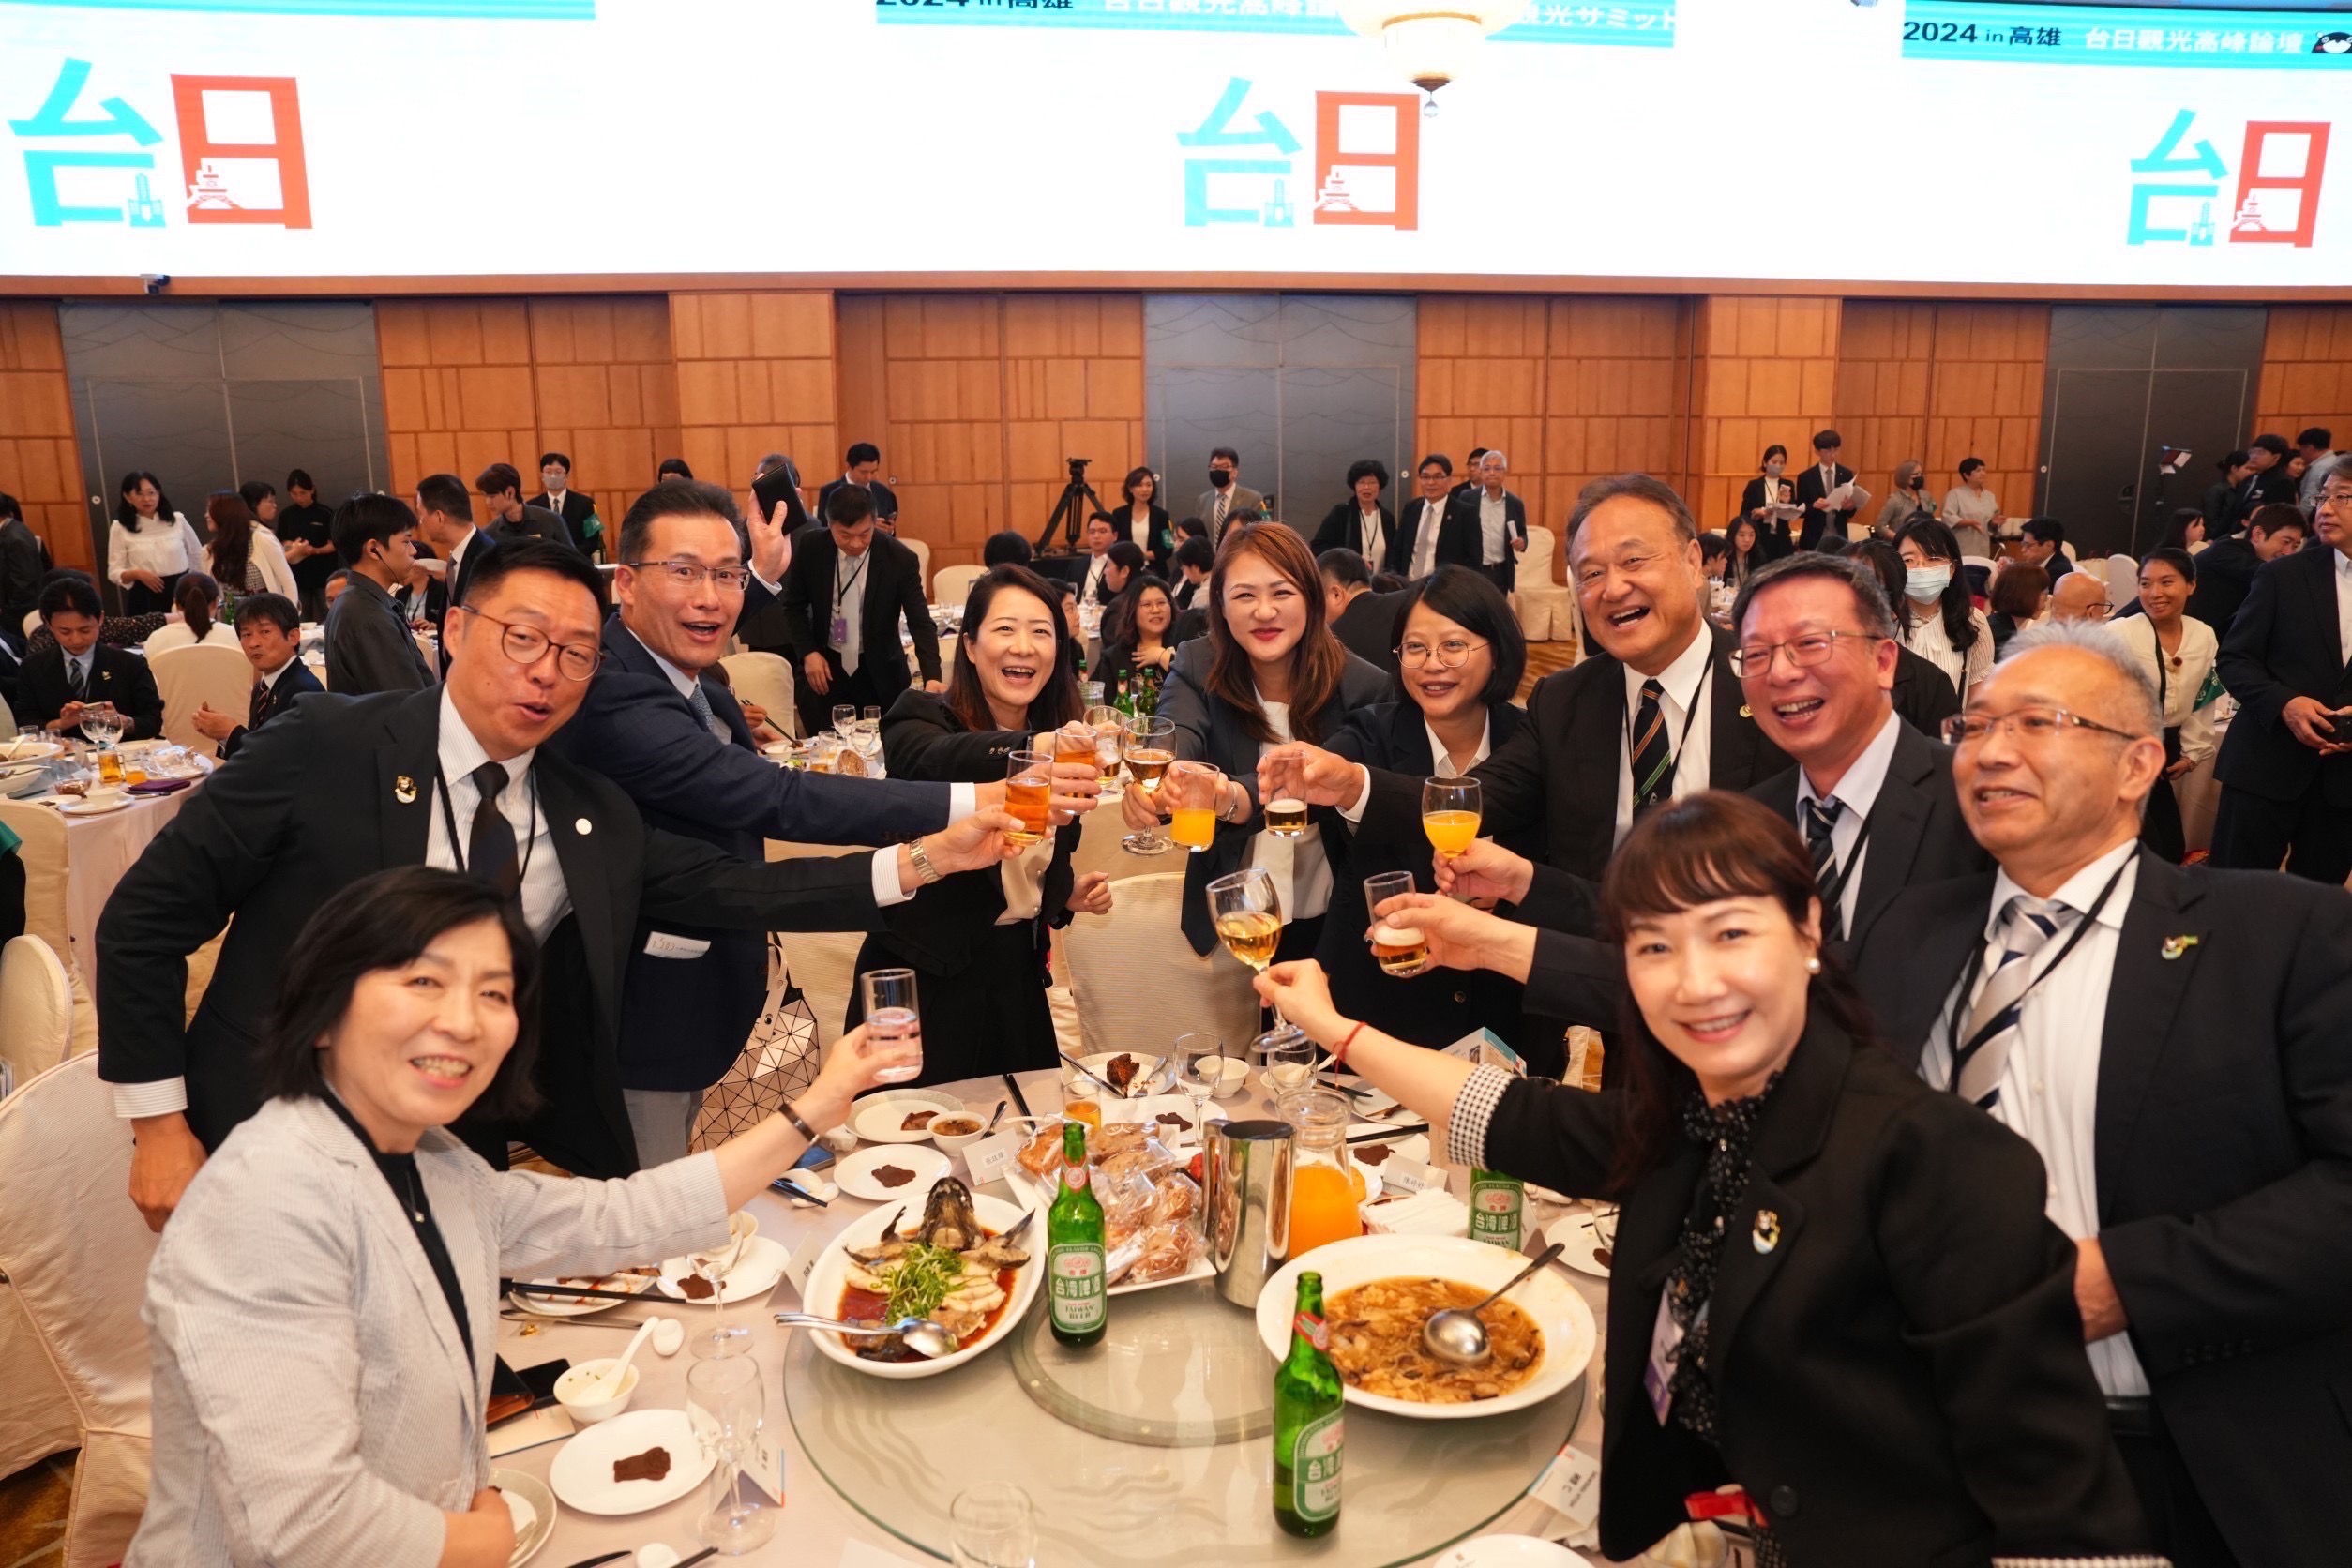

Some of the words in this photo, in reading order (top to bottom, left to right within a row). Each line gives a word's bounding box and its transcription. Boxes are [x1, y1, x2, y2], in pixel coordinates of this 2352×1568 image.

[1902, 21, 1979, 43] 2024
[1985, 29, 2004, 43] in
[2009, 25, 2062, 46] 高雄
[2085, 27, 2304, 53] 台日觀光高峰論壇
[8, 57, 313, 230] 台日
[1176, 76, 1421, 231] 台日
[2126, 109, 2331, 248] 台日
